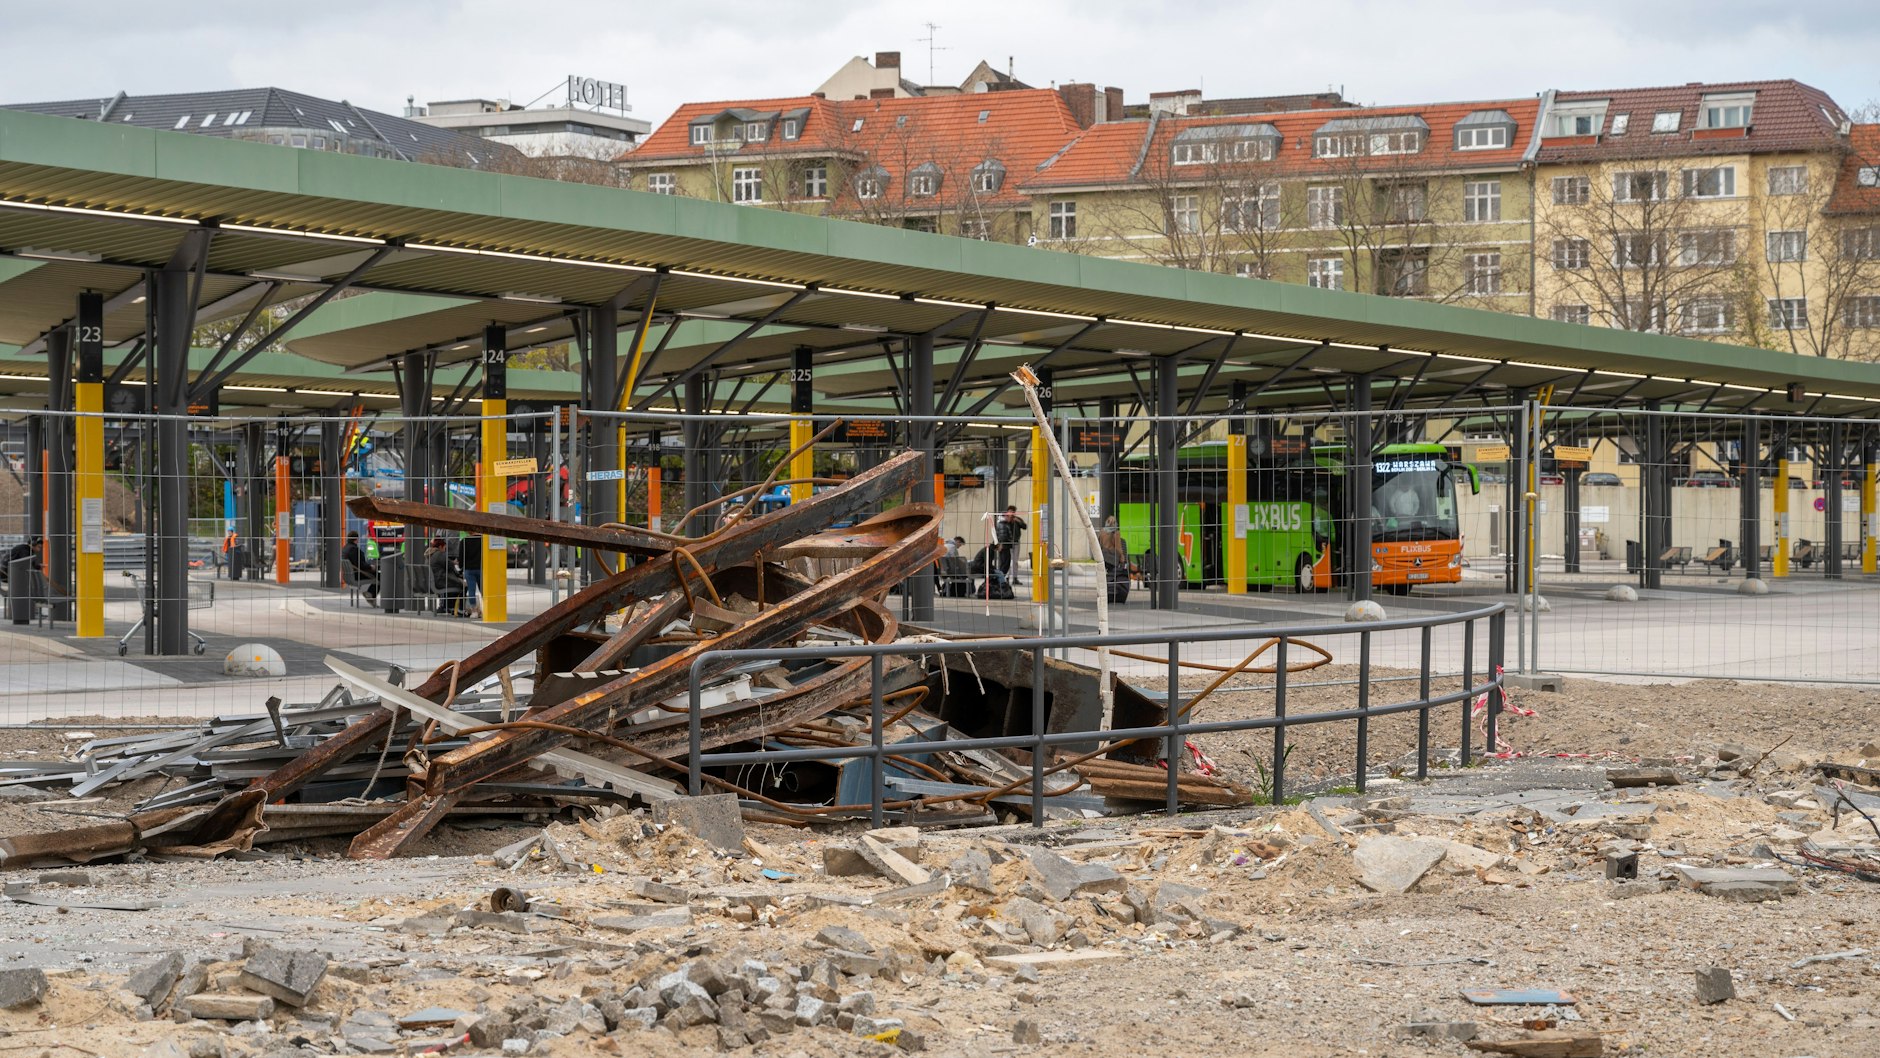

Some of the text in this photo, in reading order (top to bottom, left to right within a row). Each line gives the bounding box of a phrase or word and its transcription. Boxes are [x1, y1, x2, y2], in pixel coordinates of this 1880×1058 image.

[568, 75, 632, 111] HOTEL
[82, 326, 101, 343] 23
[488, 349, 505, 364] 24
[797, 369, 812, 382] 25
[1039, 386, 1052, 398] 26
[1234, 436, 1246, 447] 27
[1376, 460, 1436, 473] 1322 WARSZAWA
[590, 470, 623, 480] HERAS
